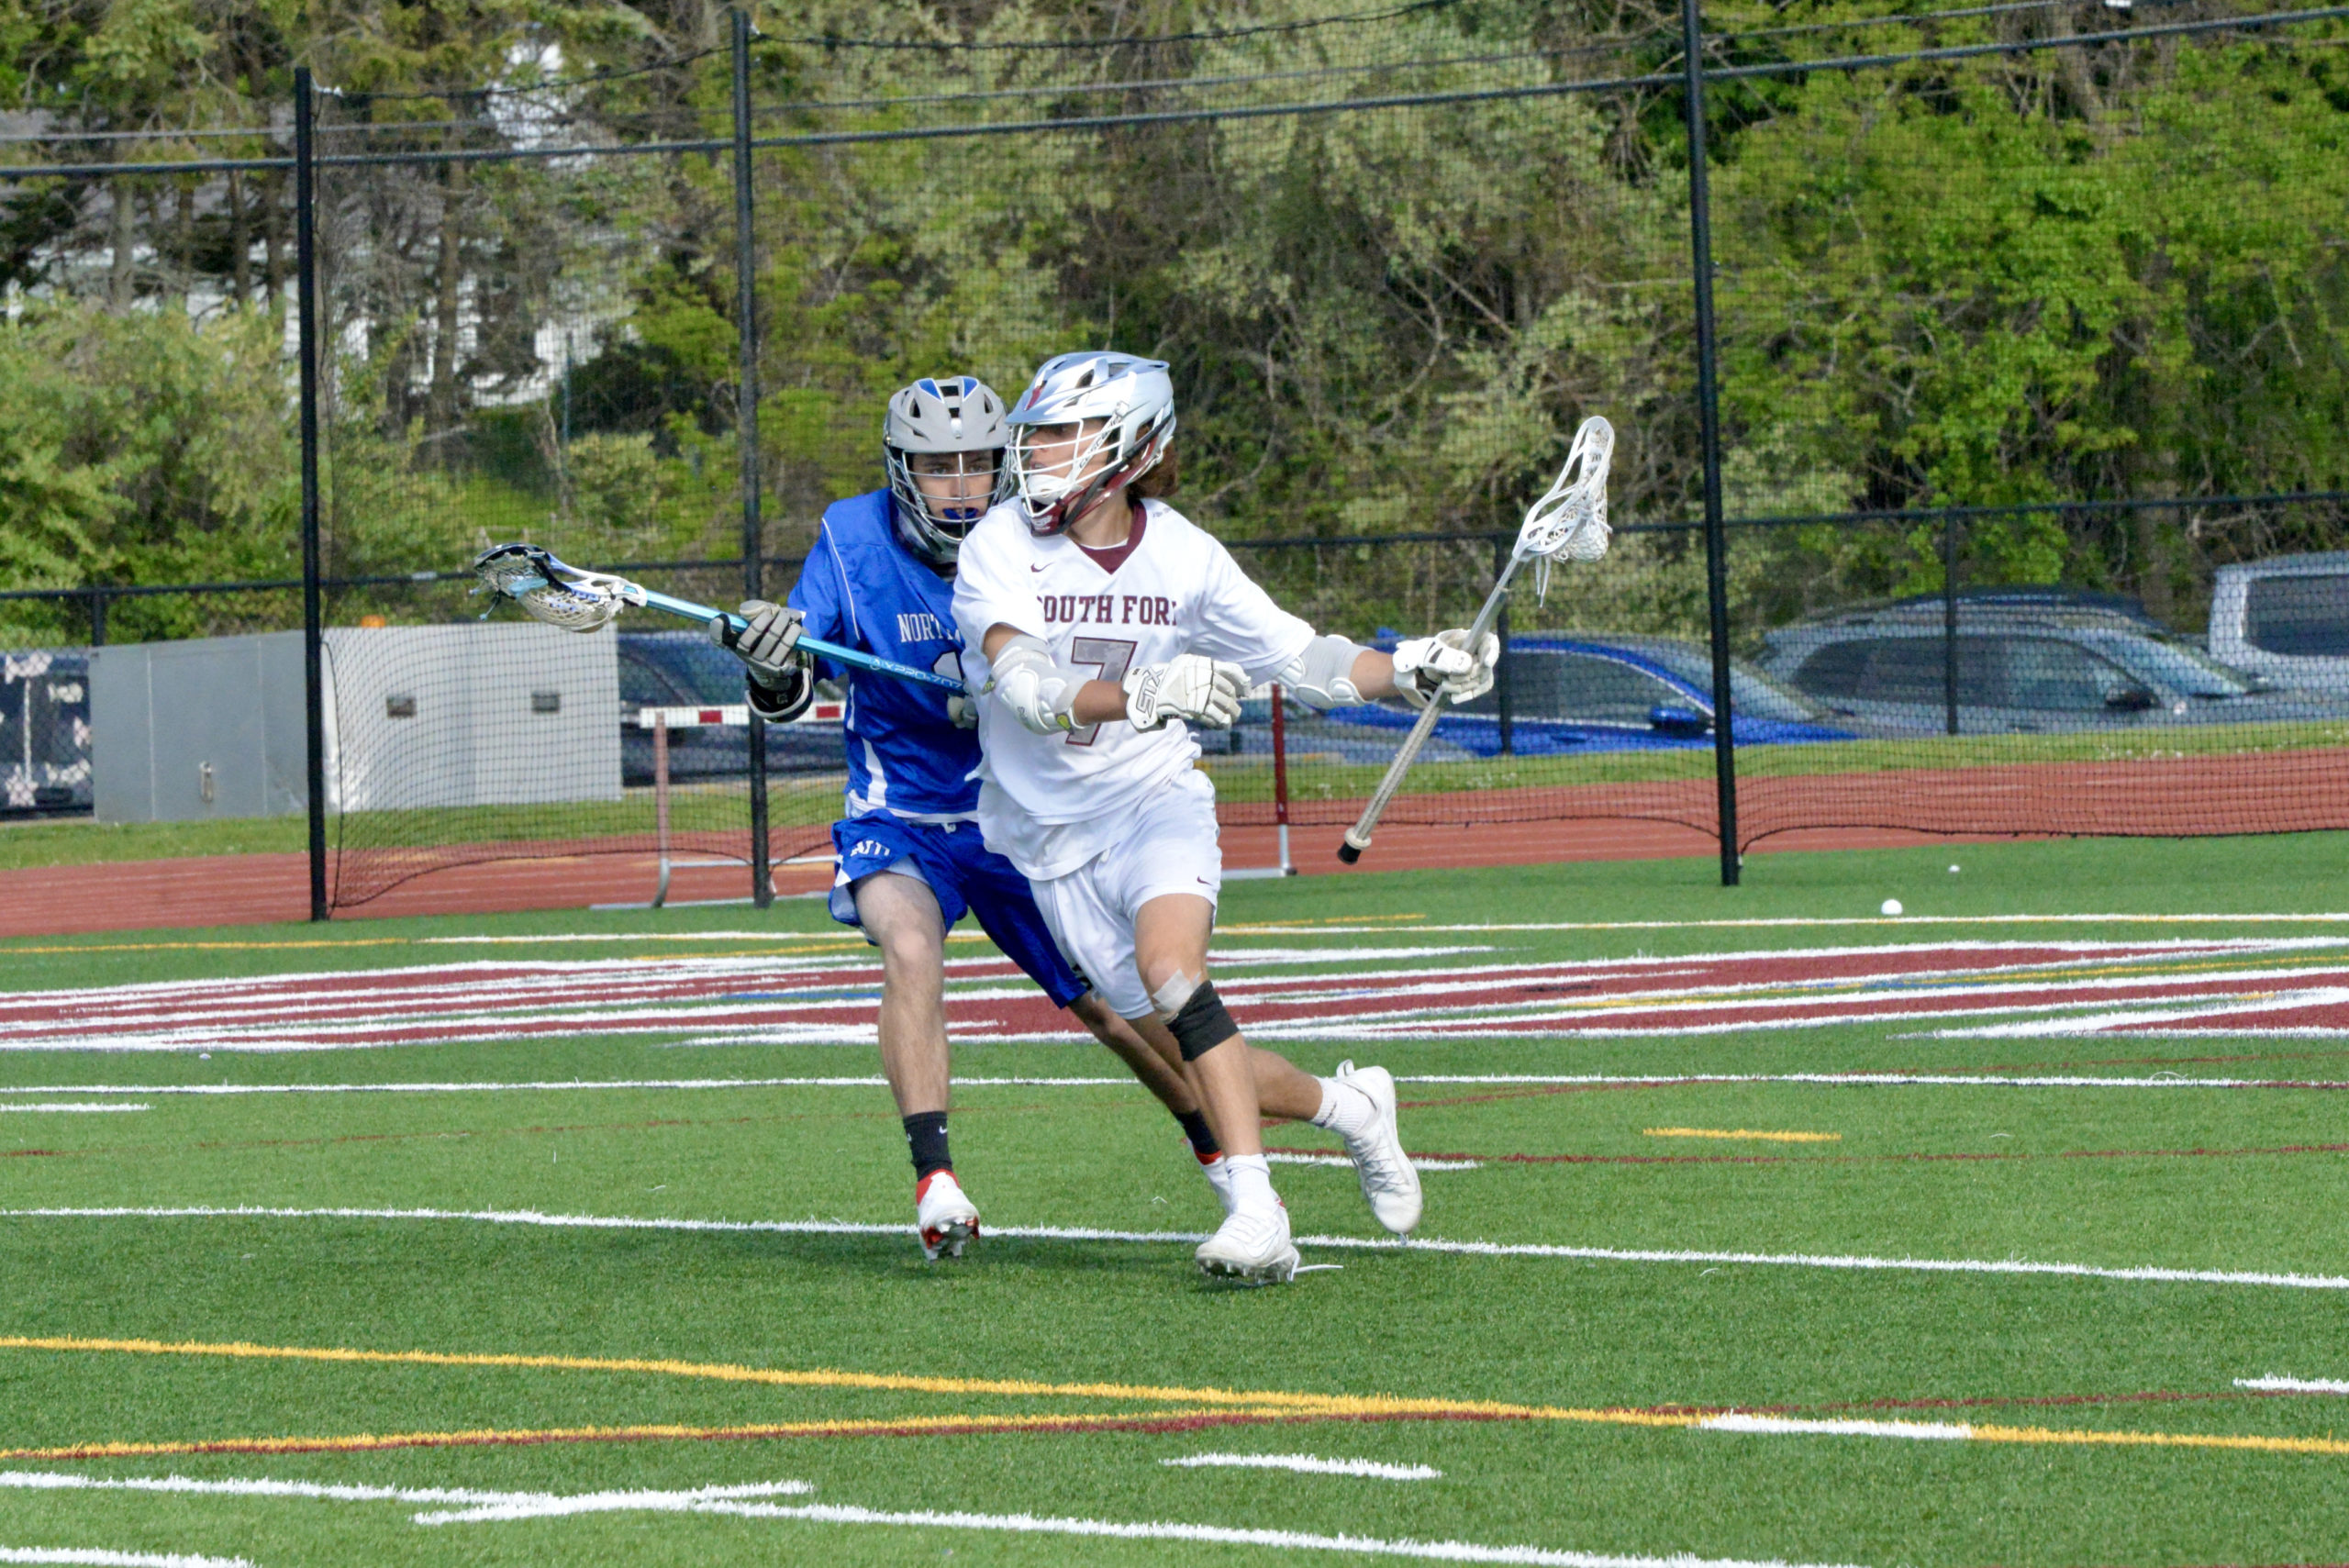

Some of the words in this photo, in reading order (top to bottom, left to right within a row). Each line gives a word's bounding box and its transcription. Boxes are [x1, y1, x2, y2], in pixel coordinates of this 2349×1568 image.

[1037, 595, 1114, 623] OUTH
[1065, 637, 1138, 746] 7
[1136, 667, 1164, 719] STX
